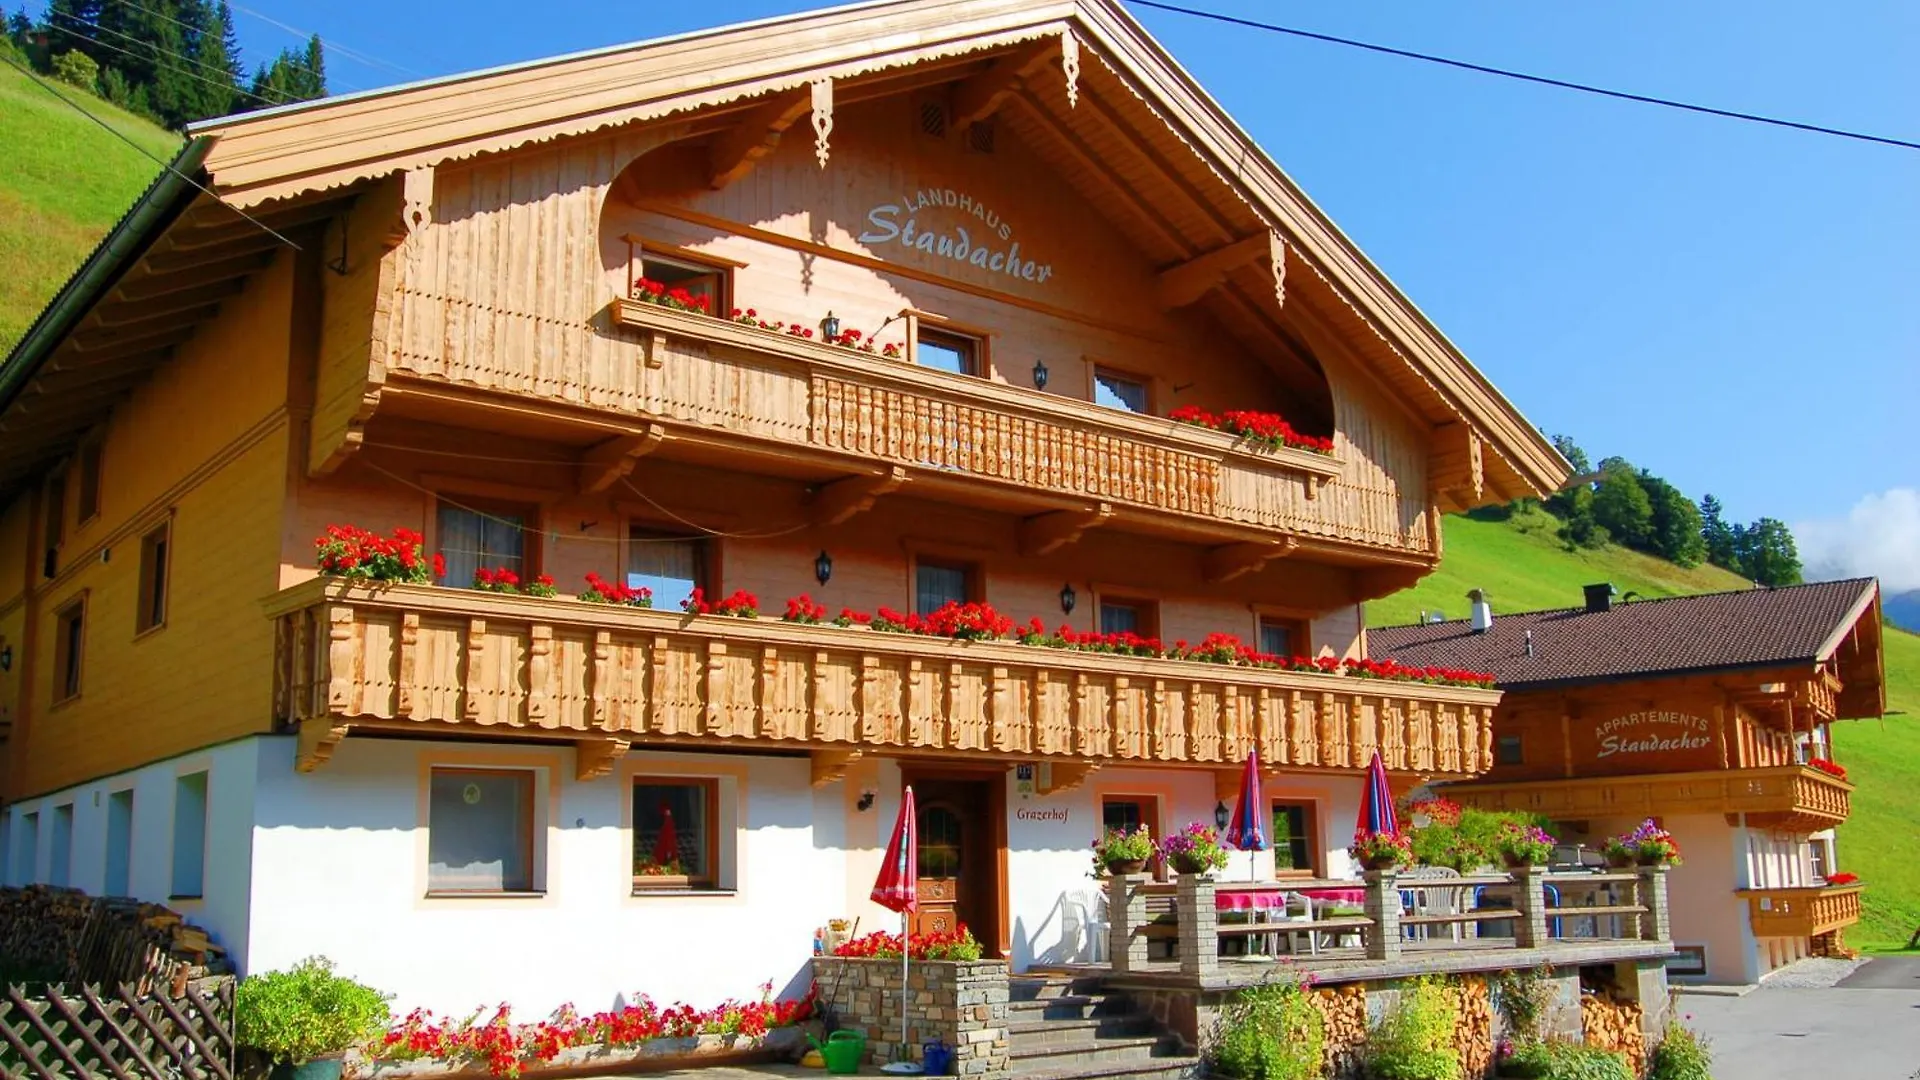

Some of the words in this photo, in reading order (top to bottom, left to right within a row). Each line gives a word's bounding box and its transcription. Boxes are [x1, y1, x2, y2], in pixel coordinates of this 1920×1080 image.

[903, 188, 1012, 241] LANDHAUS
[858, 204, 1053, 283] Staudacher
[1595, 711, 1709, 738] APPARTEMENTS
[1597, 731, 1712, 758] Staudacher
[1017, 807, 1069, 824] Grazerhof
